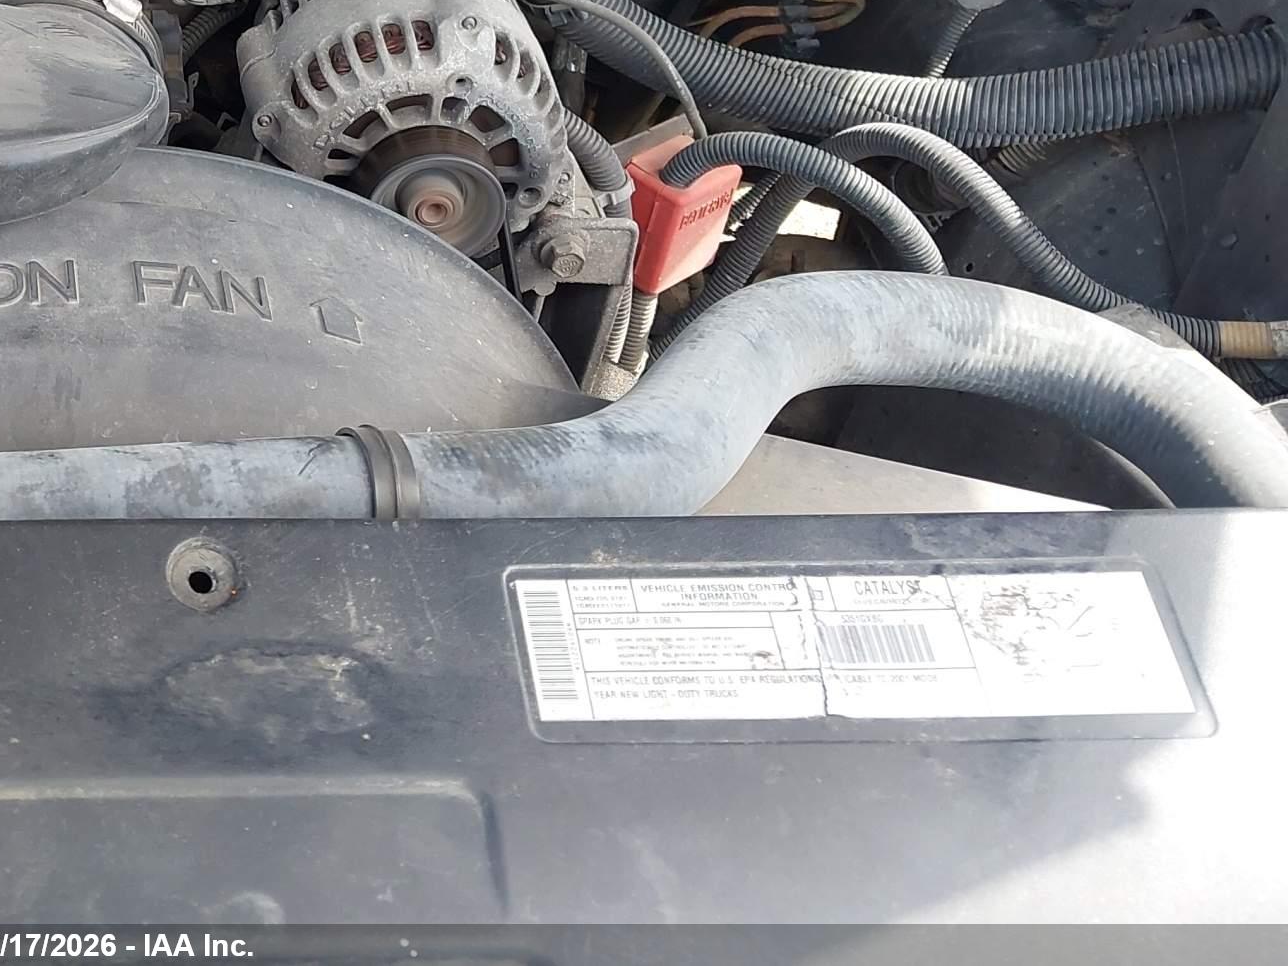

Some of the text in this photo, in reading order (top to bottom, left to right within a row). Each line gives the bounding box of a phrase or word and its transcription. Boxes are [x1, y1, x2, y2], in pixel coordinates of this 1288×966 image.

[131, 259, 274, 322] FAN
[640, 584, 685, 593] VEHICLE
[690, 583, 746, 592] EMISSION
[853, 580, 921, 596] CATALYST
[680, 592, 758, 601] INFORMATION
[591, 676, 610, 685] THIS
[614, 676, 650, 685] VEHICLE
[652, 676, 700, 684] CONFORMS
